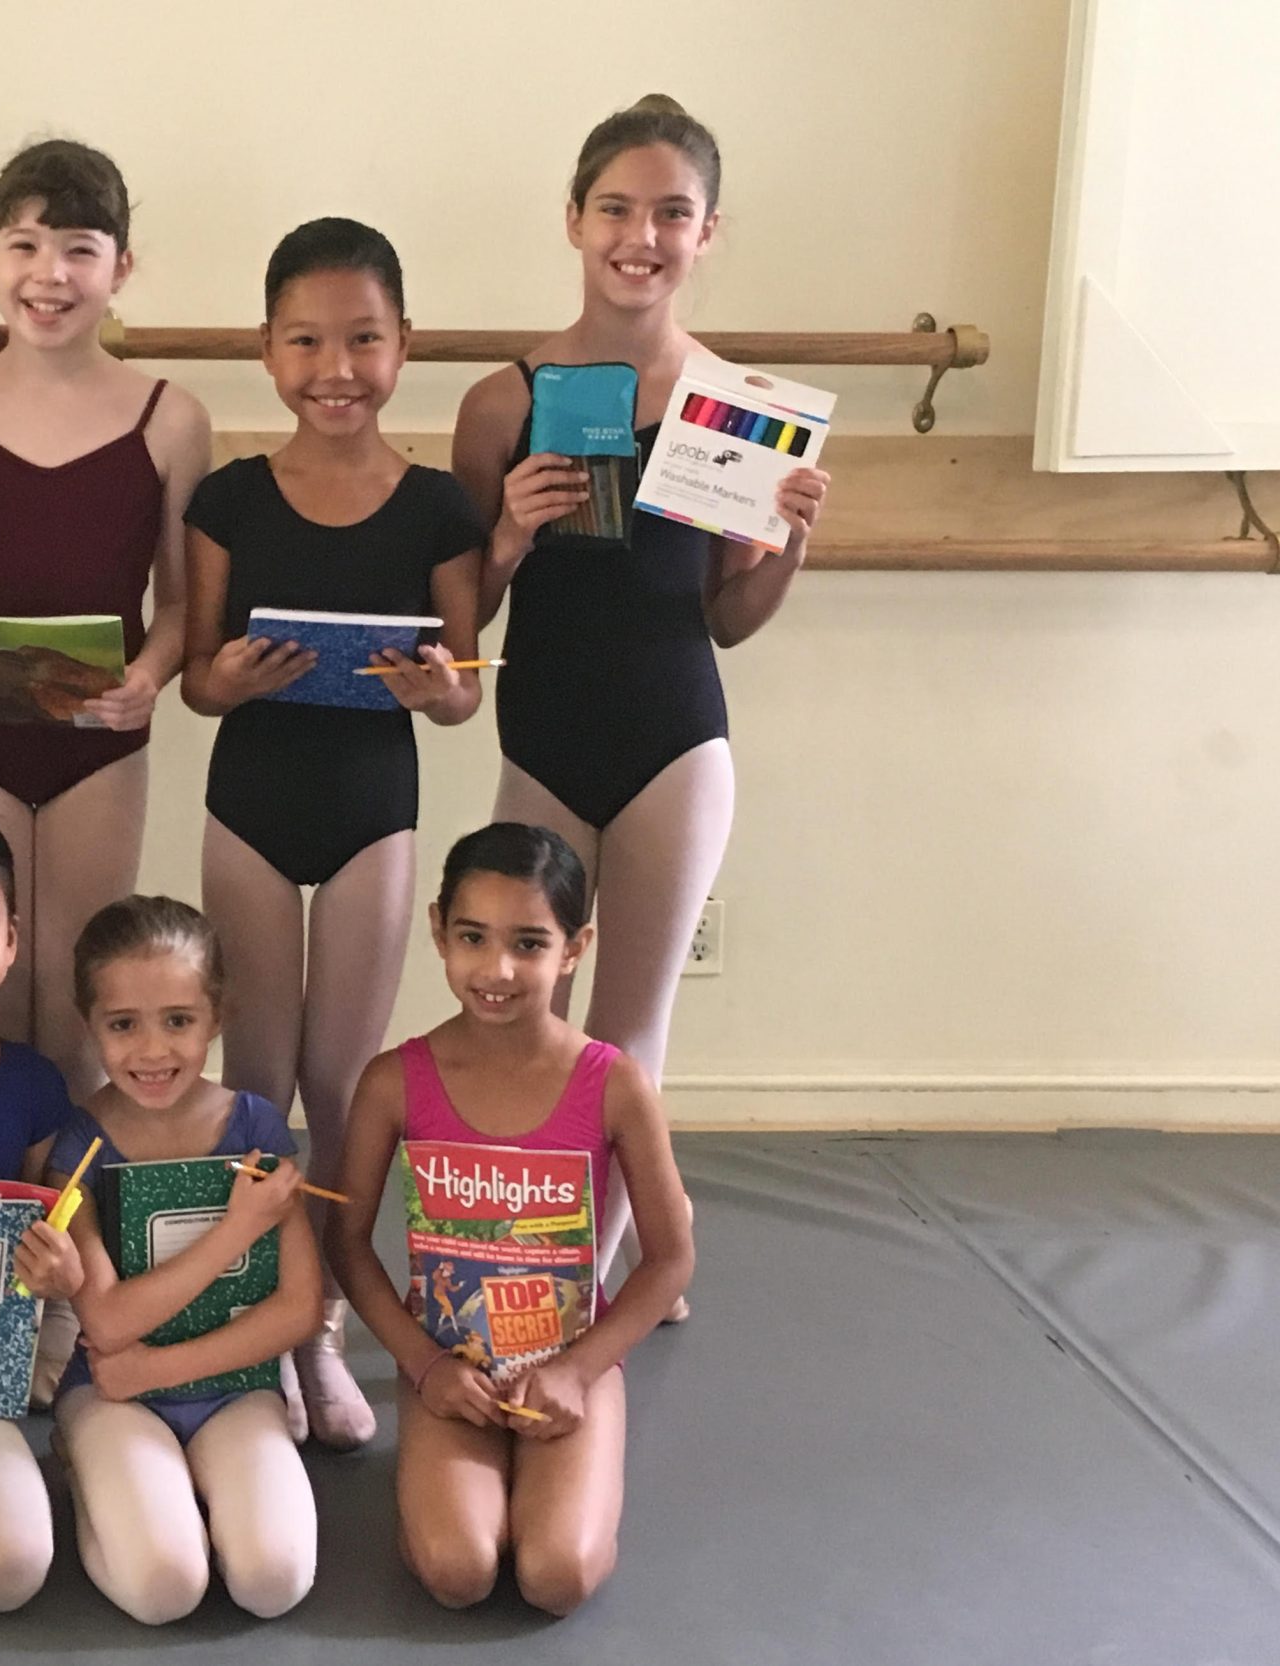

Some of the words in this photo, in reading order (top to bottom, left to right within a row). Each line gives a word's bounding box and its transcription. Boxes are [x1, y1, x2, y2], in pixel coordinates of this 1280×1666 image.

[666, 441, 710, 462] yoobi
[660, 469, 710, 491] Washable
[713, 484, 756, 508] Markers
[416, 1156, 575, 1213] Highlights
[486, 1279, 550, 1312] TOP
[492, 1312, 556, 1346] SECRET
